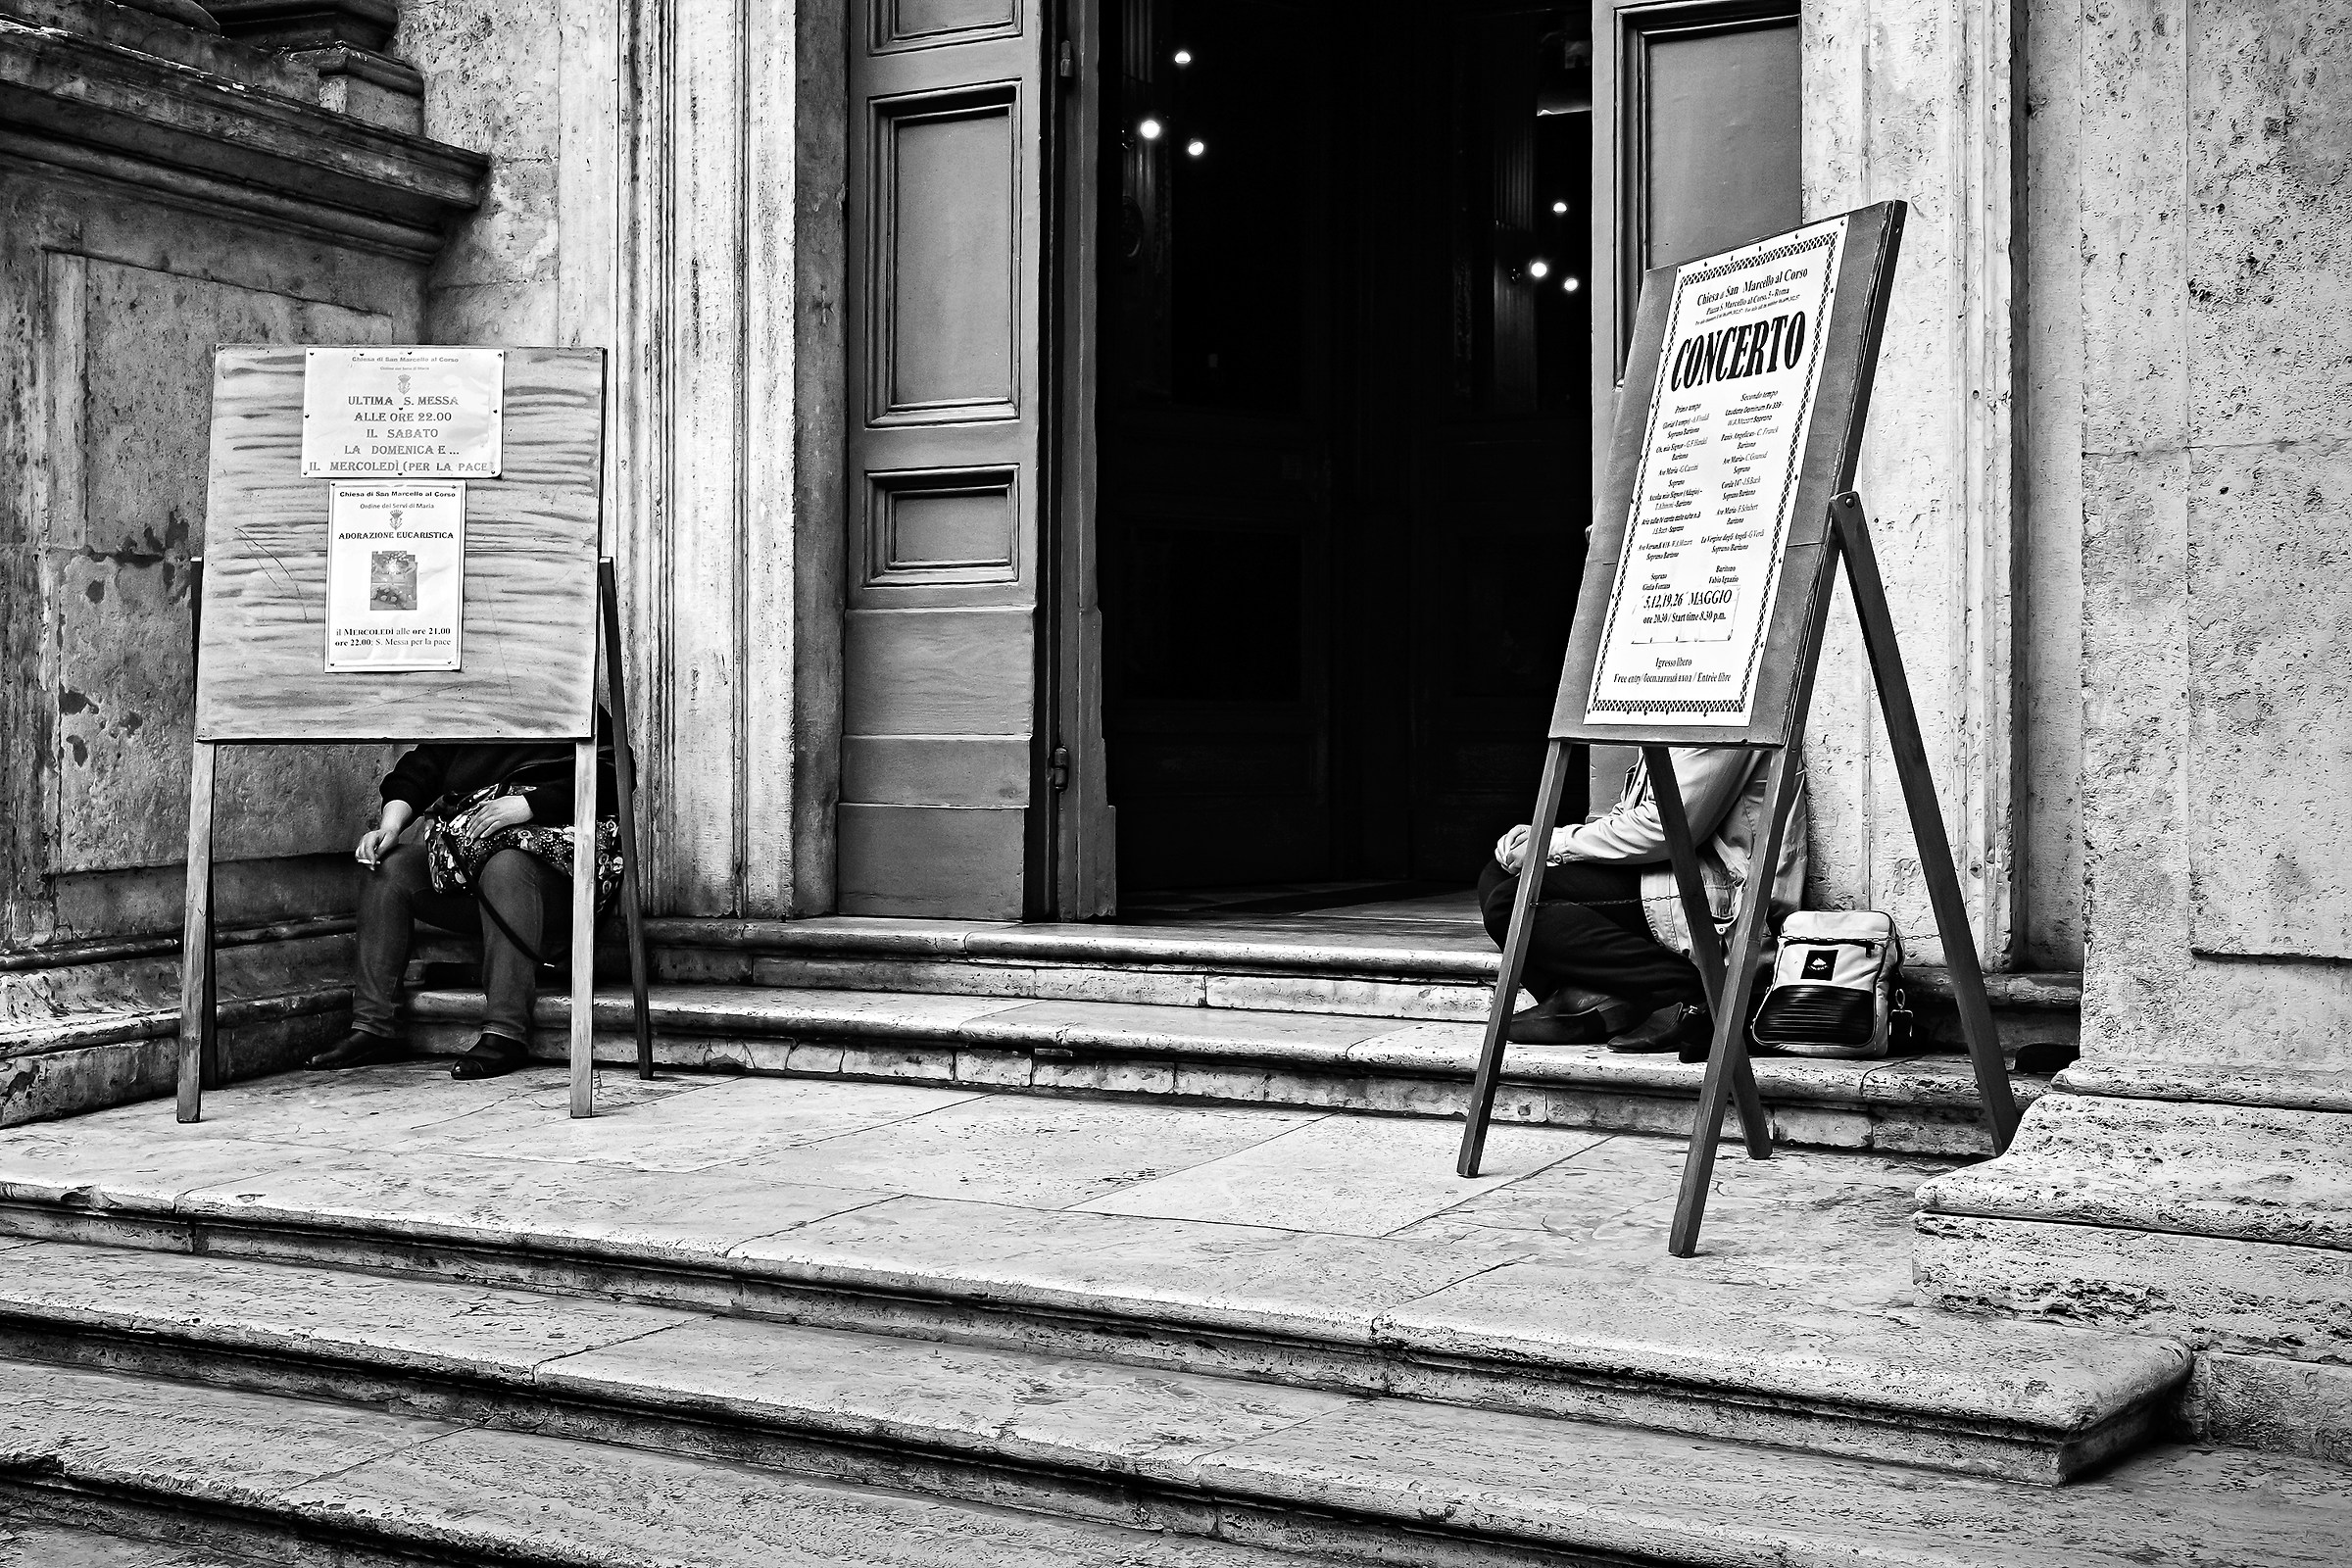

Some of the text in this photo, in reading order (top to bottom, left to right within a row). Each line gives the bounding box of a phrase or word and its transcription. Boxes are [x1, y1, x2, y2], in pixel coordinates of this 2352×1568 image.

[1697, 293, 1720, 307] Chiesa
[1726, 285, 1740, 297] San
[1742, 275, 1775, 294] Marcello
[1775, 271, 1784, 285] al
[1785, 269, 1808, 281] Corso
[1724, 298, 1747, 310] Marcello
[1747, 295, 1753, 305] al
[1775, 288, 1790, 297] Roma
[1671, 311, 1806, 392] CONCERTO
[348, 396, 459, 406] ULTIMA S. MESSA
[354, 413, 452, 422] ALLE ORE 22.00
[367, 429, 439, 438] IL SABATO
[344, 445, 361, 455] LA
[371, 445, 434, 455] DOMENICA
[309, 462, 320, 471] IL
[329, 460, 400, 471] MERCOLEDÌ
[403, 461, 430, 472] (PER
[436, 463, 452, 471] LA
[1688, 589, 1733, 606] MAGGIO
[1643, 615, 1653, 624] ore
[1672, 612, 1687, 622] Start
[1686, 612, 1699, 621] time
[1676, 658, 1692, 667] libero
[1613, 673, 1628, 683] Free
[1718, 672, 1732, 682] libre
